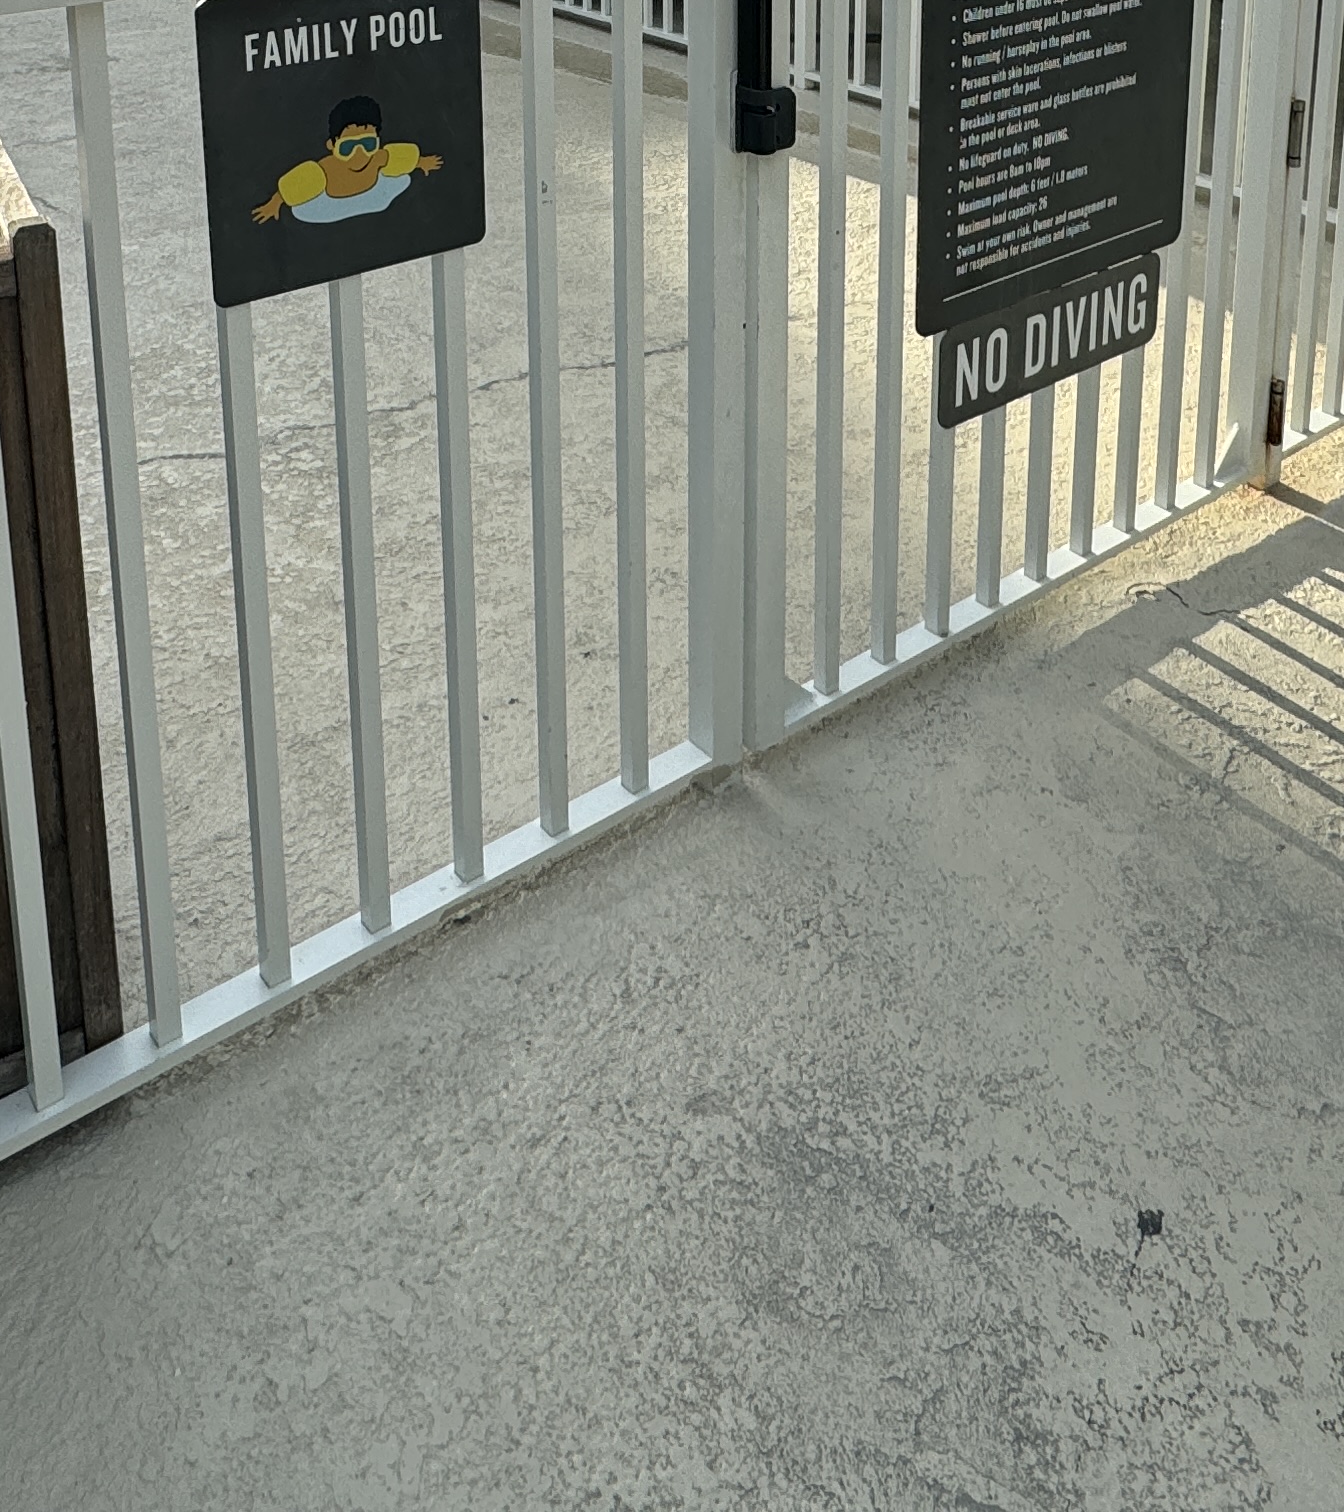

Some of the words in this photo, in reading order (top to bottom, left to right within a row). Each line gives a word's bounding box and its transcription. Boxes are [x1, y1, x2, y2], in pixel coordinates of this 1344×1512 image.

[1062, 11, 1070, 23] Do
[245, 18, 357, 72] FAMILY
[370, 6, 443, 51] POOL
[962, 55, 972, 68] No
[961, 75, 990, 92] Persons
[959, 158, 969, 171] No
[1033, 135, 1042, 150] NO
[959, 176, 974, 194] Pool
[958, 199, 991, 216] Maximum
[958, 220, 990, 238] Maximum
[955, 327, 1008, 408] NO
[1024, 273, 1147, 379] DIVING
